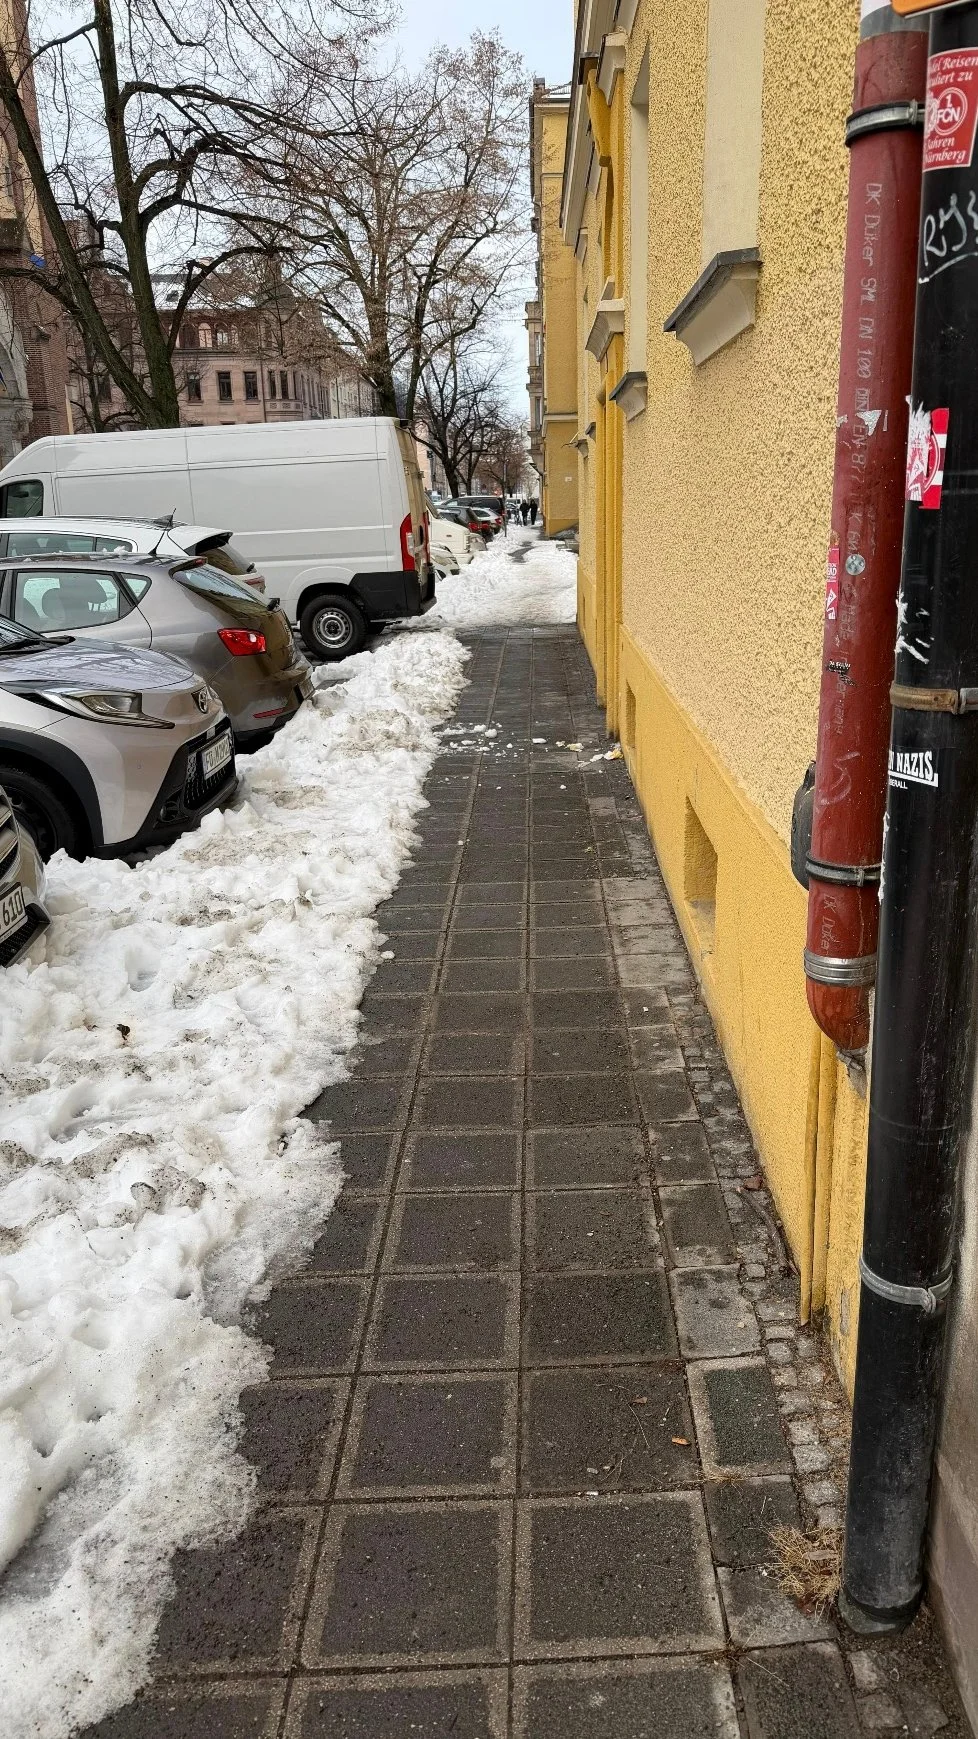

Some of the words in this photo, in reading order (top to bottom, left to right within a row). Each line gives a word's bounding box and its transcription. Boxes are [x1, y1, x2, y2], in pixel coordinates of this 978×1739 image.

[942, 55, 978, 70] Reisen
[957, 71, 973, 82] zu
[937, 107, 961, 124] FCN
[865, 183, 882, 205] DK
[860, 276, 877, 306] SML
[858, 317, 875, 339] DN
[857, 347, 873, 378] 100
[896, 750, 934, 782] NAZIS
